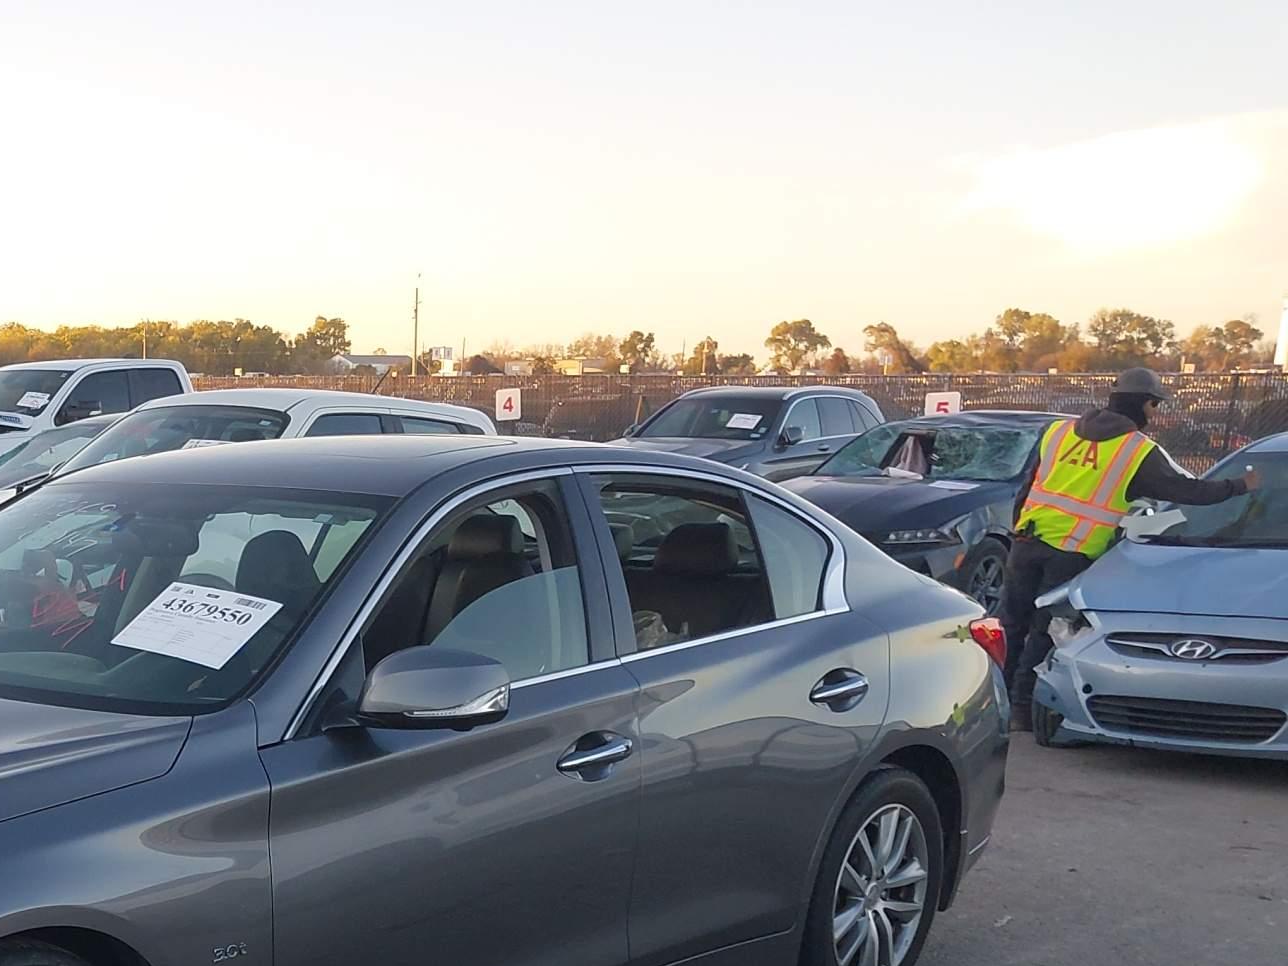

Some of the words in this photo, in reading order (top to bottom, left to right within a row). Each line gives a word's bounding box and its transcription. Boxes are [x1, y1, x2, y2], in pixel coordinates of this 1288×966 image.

[503, 396, 514, 412] 4
[936, 401, 949, 413] 5
[162, 598, 252, 625] 43679550
